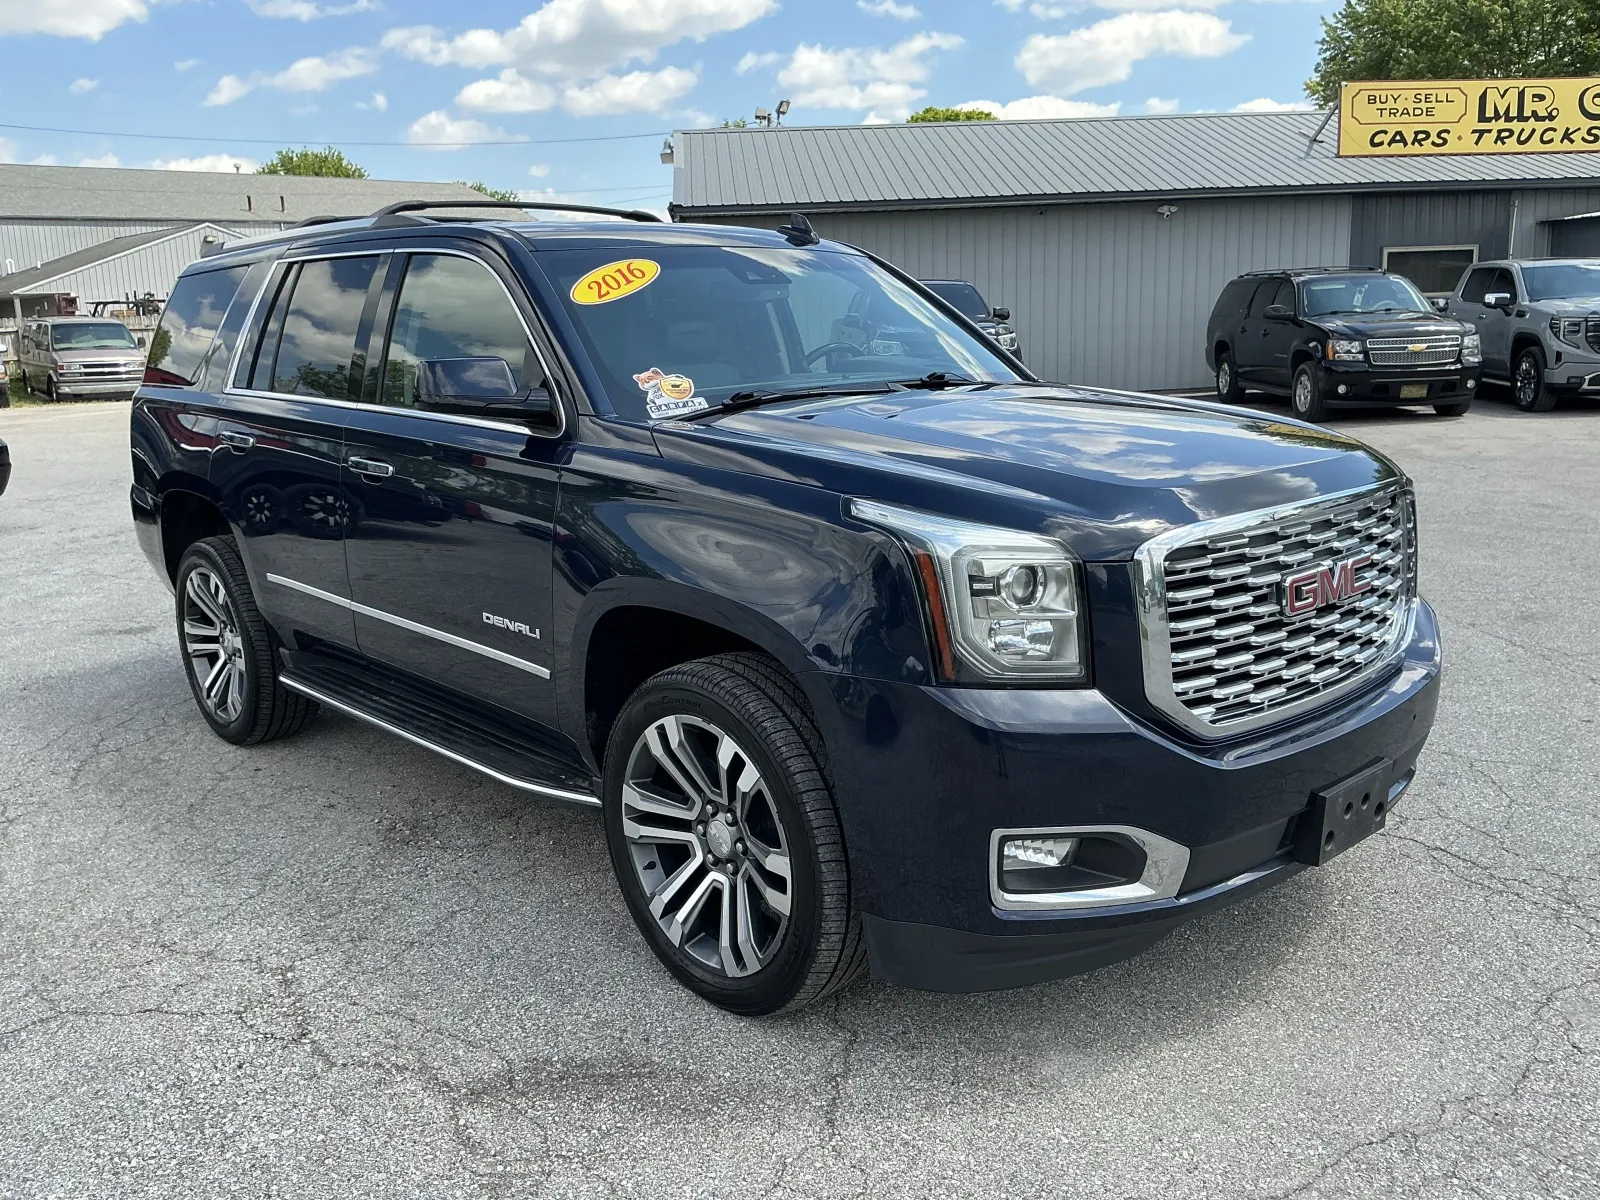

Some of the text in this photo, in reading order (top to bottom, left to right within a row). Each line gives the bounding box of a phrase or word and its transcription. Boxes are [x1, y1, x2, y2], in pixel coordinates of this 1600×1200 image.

[1367, 92, 1455, 105] BUY SELL
[1478, 85, 1560, 123] MR.
[1376, 106, 1436, 118] TRADE
[1368, 125, 1600, 149] CARS TRUCKS
[587, 261, 646, 300] 2016
[650, 399, 705, 413] CARFAX
[1283, 553, 1372, 617] GMC
[482, 611, 541, 640] DENALI
